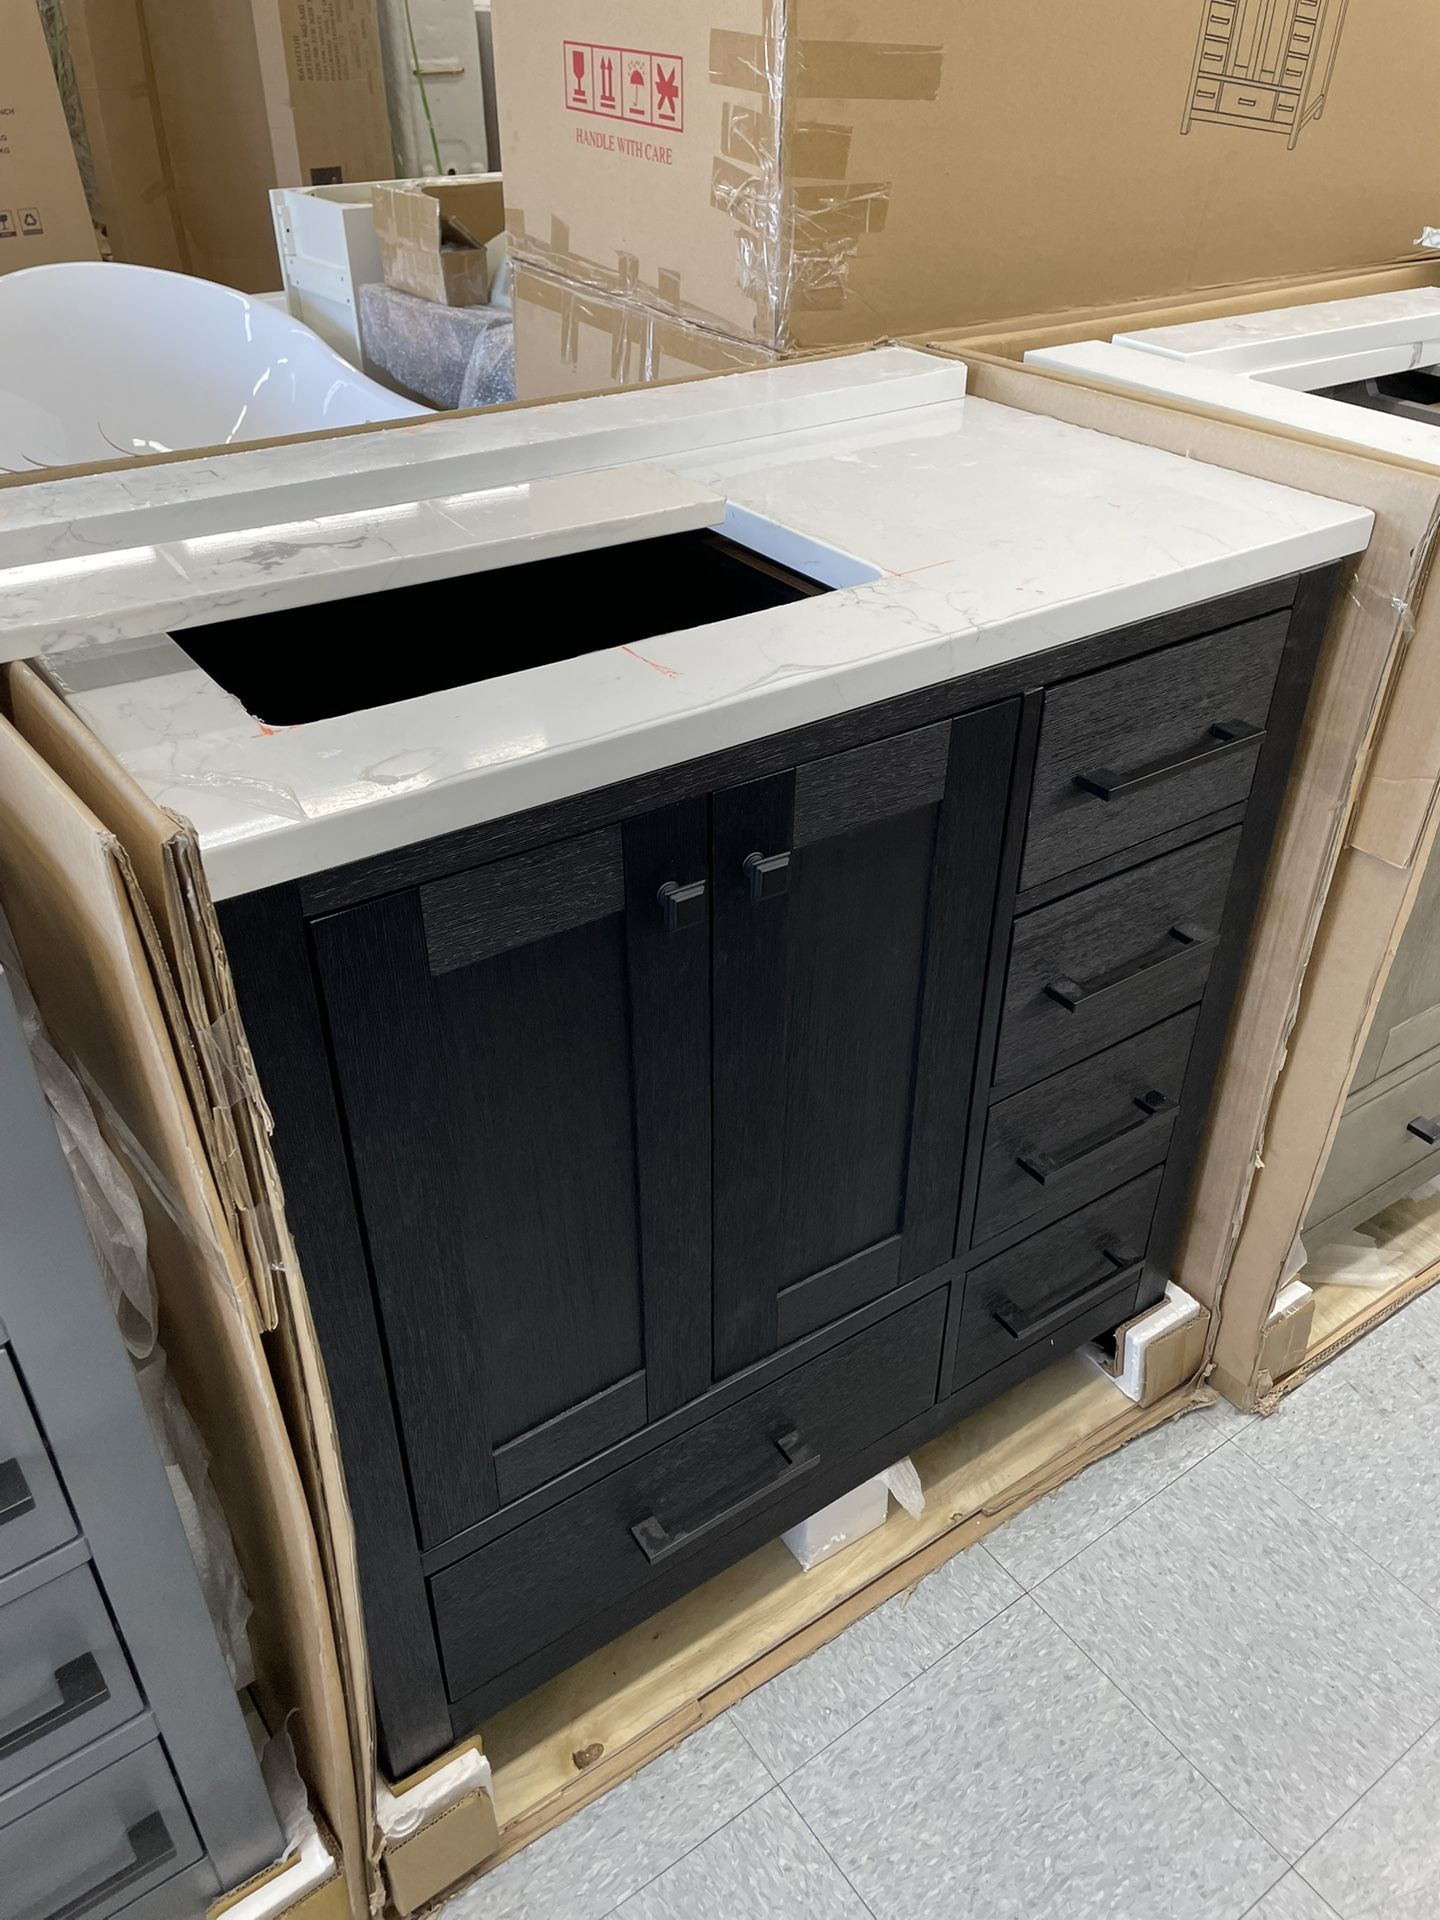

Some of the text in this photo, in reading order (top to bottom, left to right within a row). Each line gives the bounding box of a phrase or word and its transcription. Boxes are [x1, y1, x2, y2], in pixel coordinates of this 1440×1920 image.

[576, 128, 673, 166] HANDLE WITH CARE
